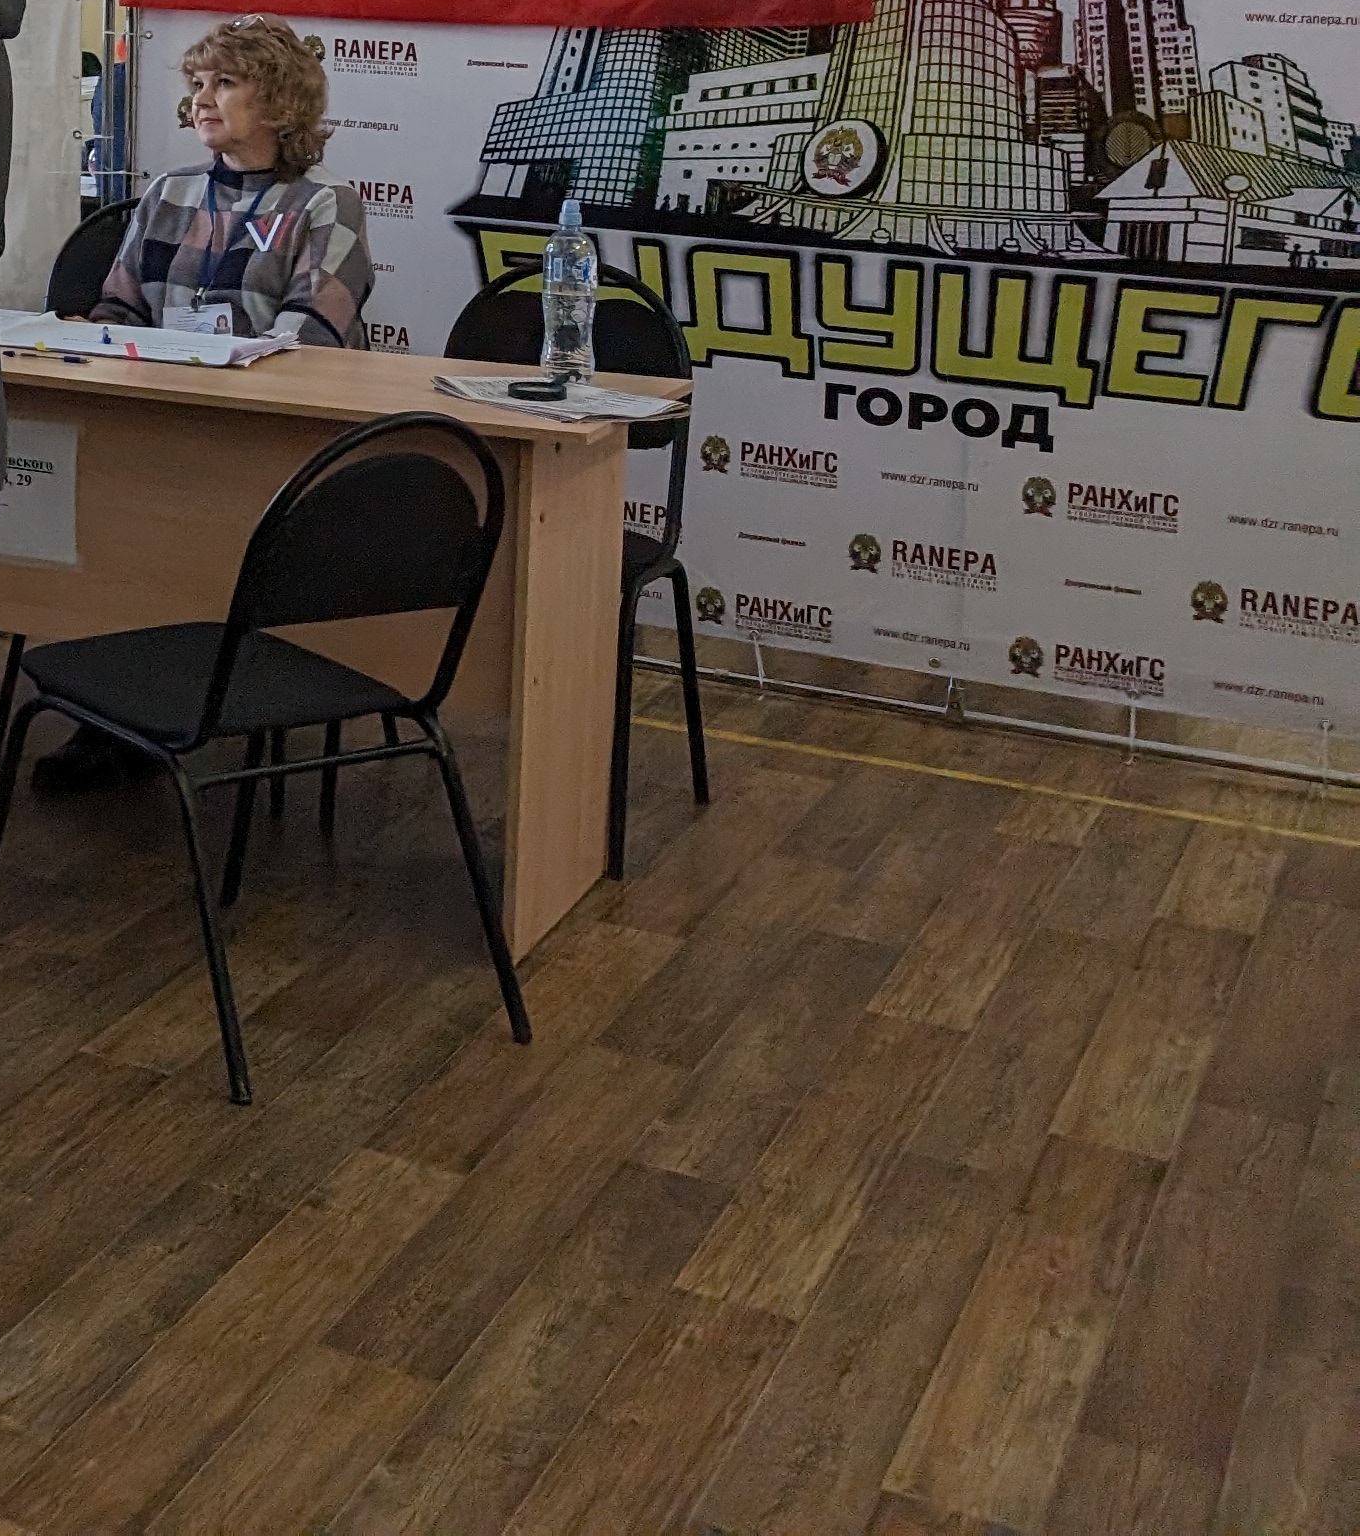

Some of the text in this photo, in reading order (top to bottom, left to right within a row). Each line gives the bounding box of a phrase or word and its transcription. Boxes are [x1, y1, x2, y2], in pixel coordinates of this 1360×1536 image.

[1244, 12, 1358, 26] www.dzr.ranepa.ru
[333, 38, 418, 62] RANEPA
[349, 179, 414, 205] NEPA
[364, 322, 410, 346] EPA
[823, 382, 1055, 454] ГОРОД
[7, 457, 53, 472] вского
[740, 441, 838, 474] РАНХиГС
[623, 501, 667, 526] NEP
[1067, 482, 1180, 517] РАНХиГС
[892, 539, 997, 576] RANEPA
[735, 593, 832, 628] РАНХиГС
[1240, 587, 1360, 627] RANEPA
[1055, 643, 1166, 682] РАНХиГС
